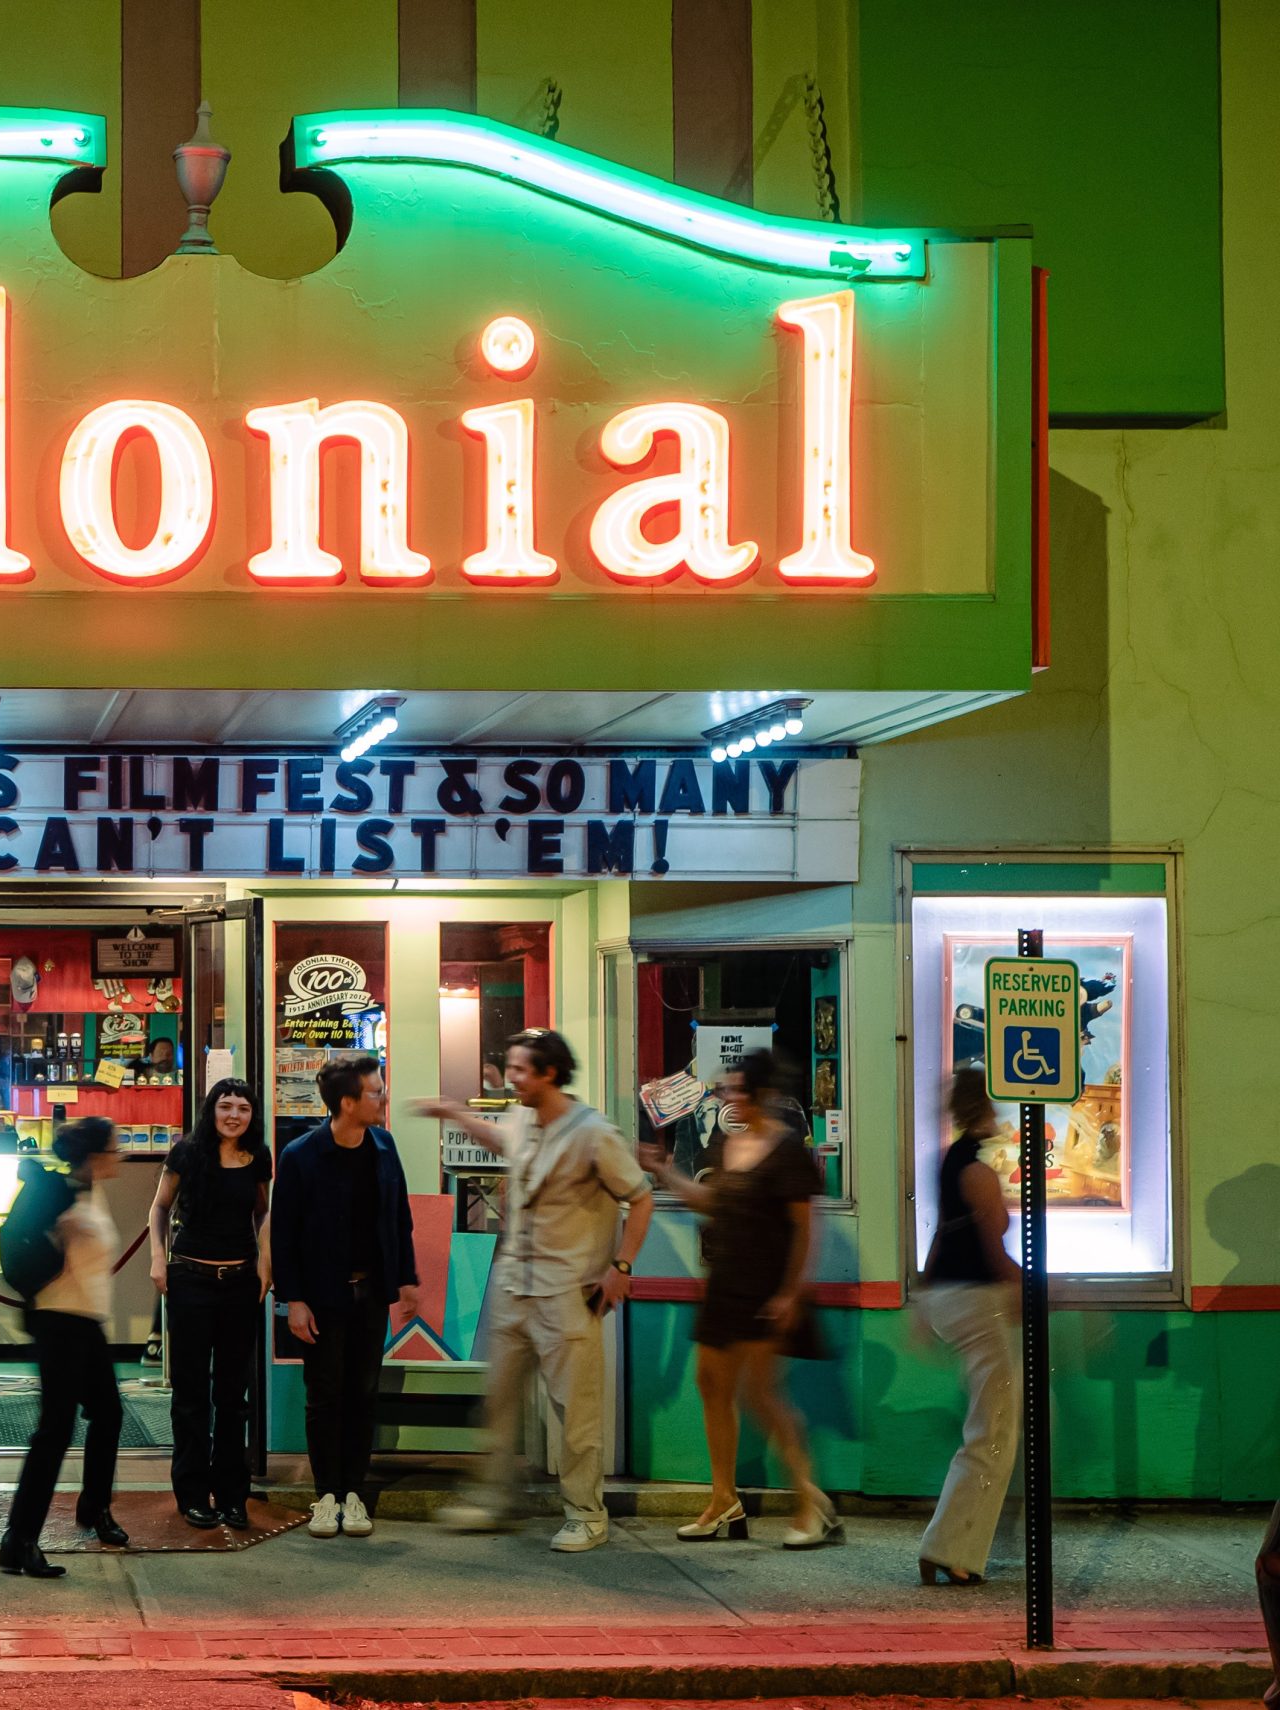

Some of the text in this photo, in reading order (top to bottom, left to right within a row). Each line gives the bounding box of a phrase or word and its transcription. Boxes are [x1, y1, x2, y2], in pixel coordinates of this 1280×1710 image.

[64, 756, 219, 811] FILM
[242, 759, 415, 814] FEST
[437, 759, 484, 815] &
[499, 760, 586, 814] SO
[610, 760, 799, 815] MANY
[268, 819, 447, 874] LIST
[496, 819, 670, 875] 'EM!
[112, 943, 160, 951] WELCOME
[119, 951, 154, 959] TO THE
[293, 956, 361, 975] COLONIAL THEATRE
[992, 973, 1072, 993] RESERVED
[289, 992, 367, 1013] 1912 ANNIVERSARY 2012
[999, 998, 1066, 1018] PARKING
[284, 1018, 339, 1028] Entertaining
[292, 1030, 307, 1039] for
[308, 1030, 329, 1039] Over
[330, 1030, 344, 1039] 110
[721, 1035, 743, 1043] INDIE
[720, 1044, 745, 1053] NIGHT
